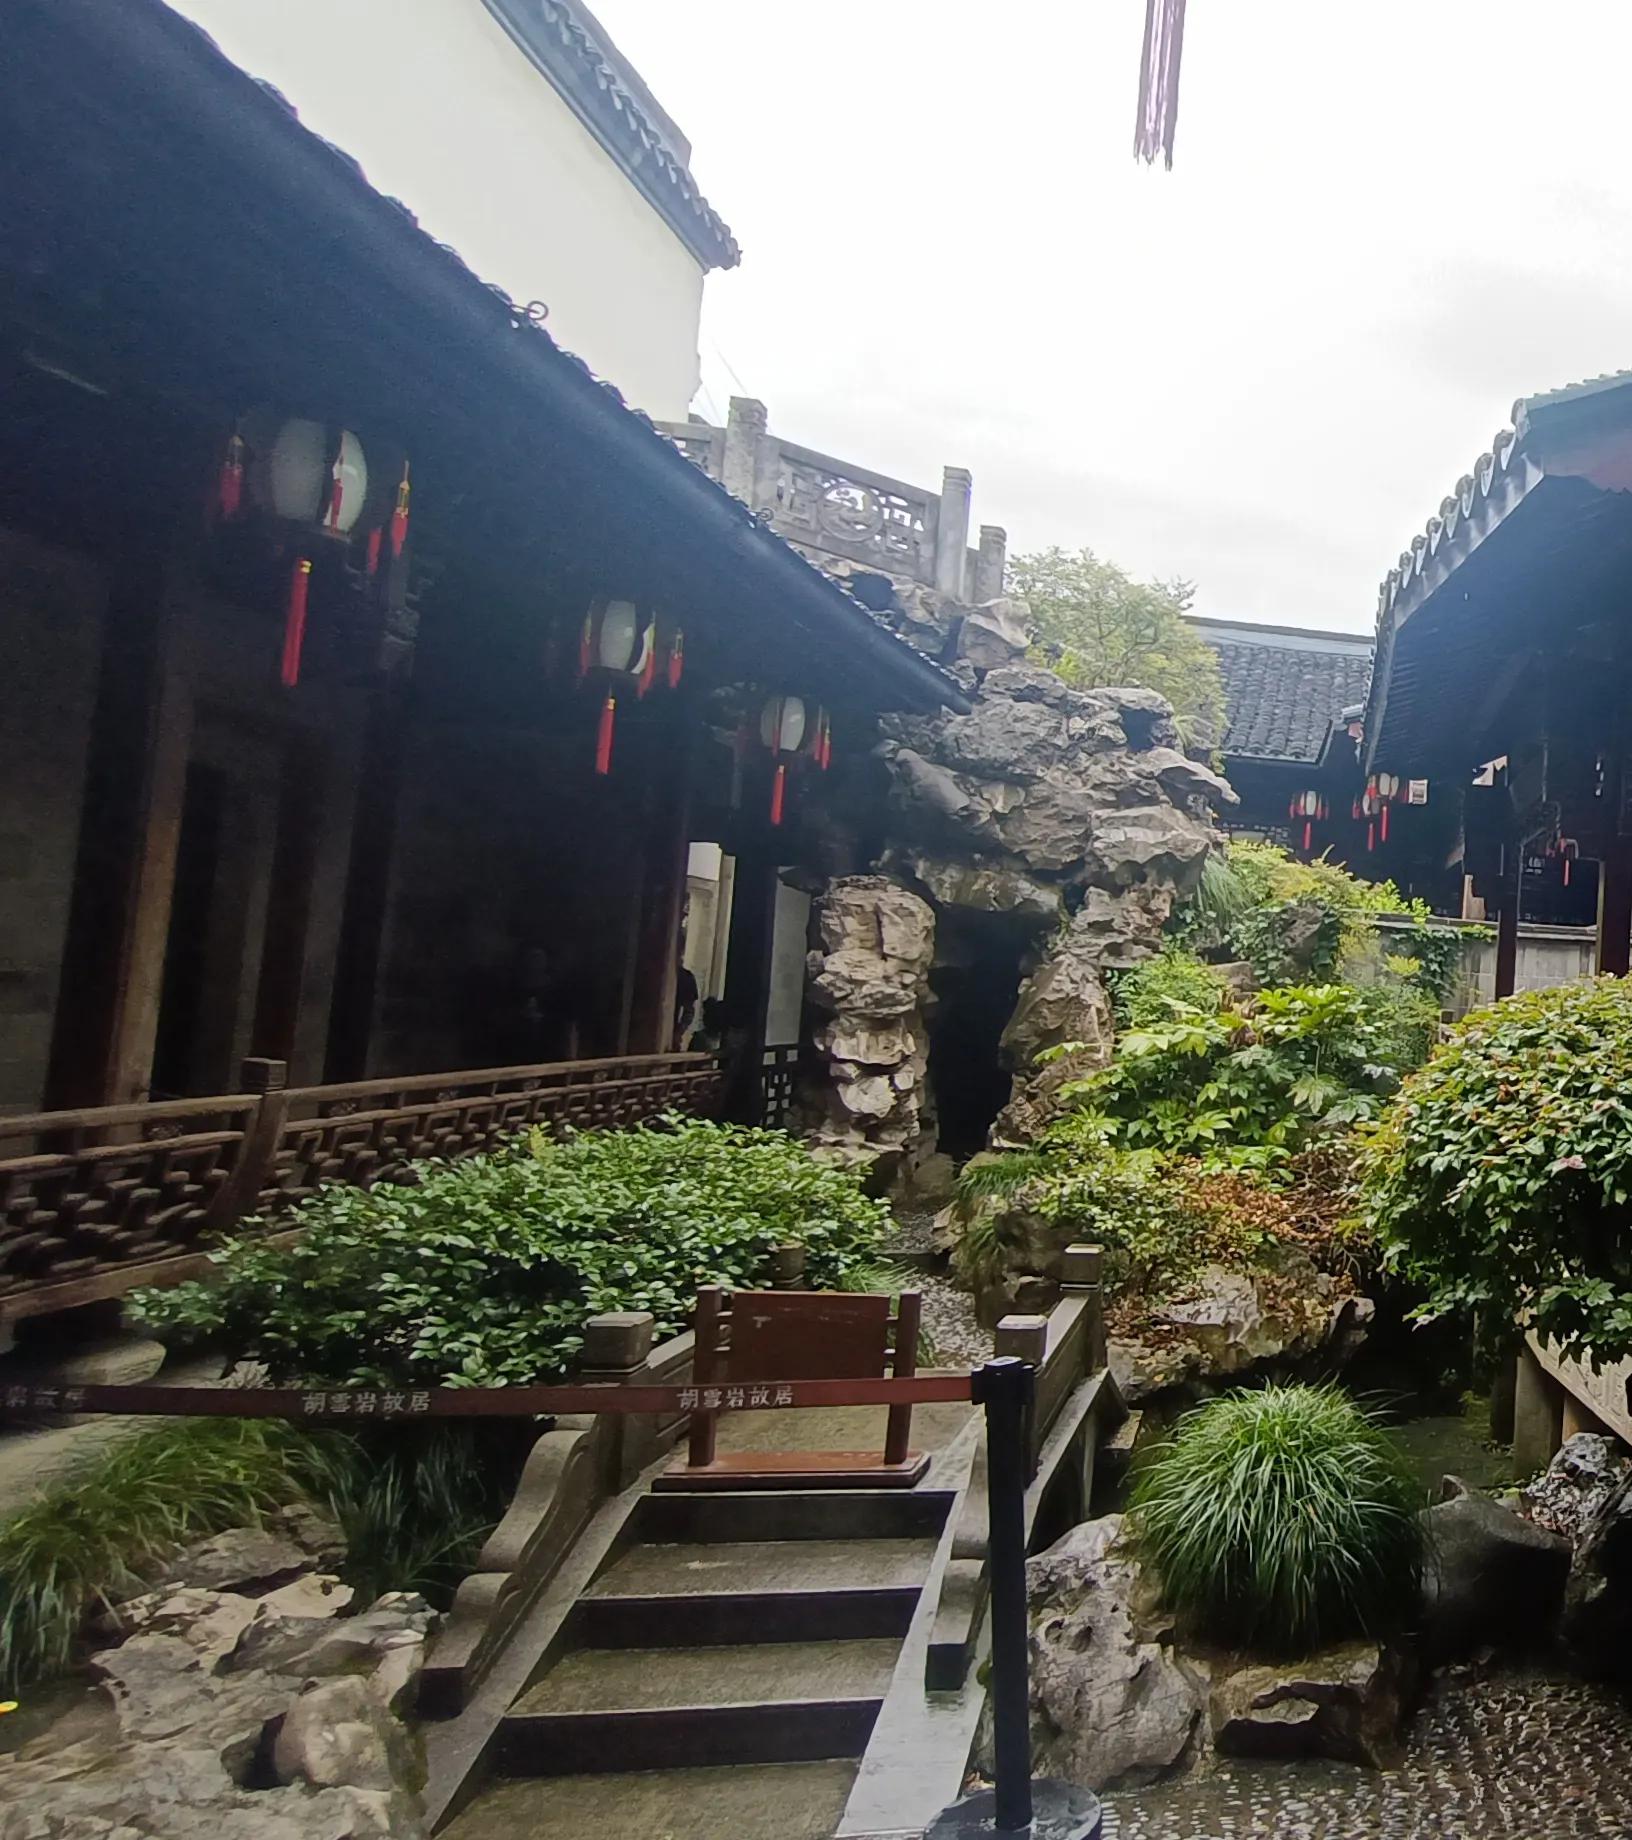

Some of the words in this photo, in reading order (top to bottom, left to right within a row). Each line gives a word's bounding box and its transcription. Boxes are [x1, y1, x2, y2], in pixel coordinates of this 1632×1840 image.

[302, 1391, 431, 1415] 胡雪岩故居
[676, 1386, 794, 1410] 胡雪岩故居
